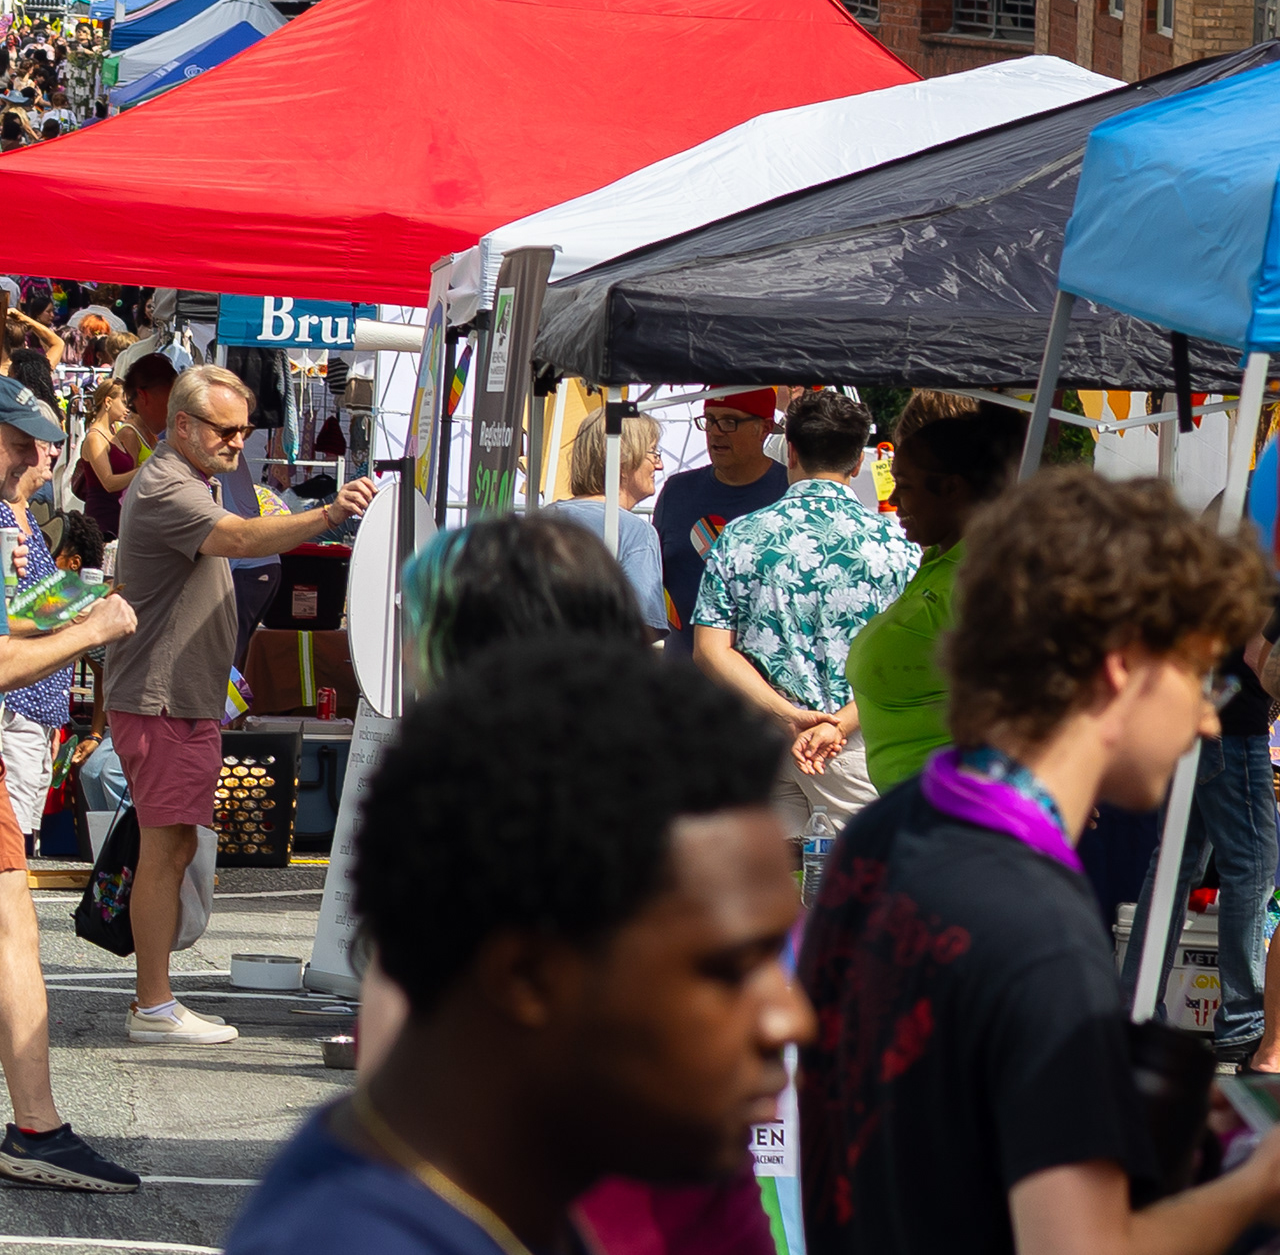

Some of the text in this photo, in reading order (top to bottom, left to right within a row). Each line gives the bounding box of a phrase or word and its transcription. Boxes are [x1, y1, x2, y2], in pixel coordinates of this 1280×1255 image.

[1185, 951, 1219, 965] YETI
[756, 1128, 785, 1146] EN
[756, 1155, 785, 1165] ACEMENT
